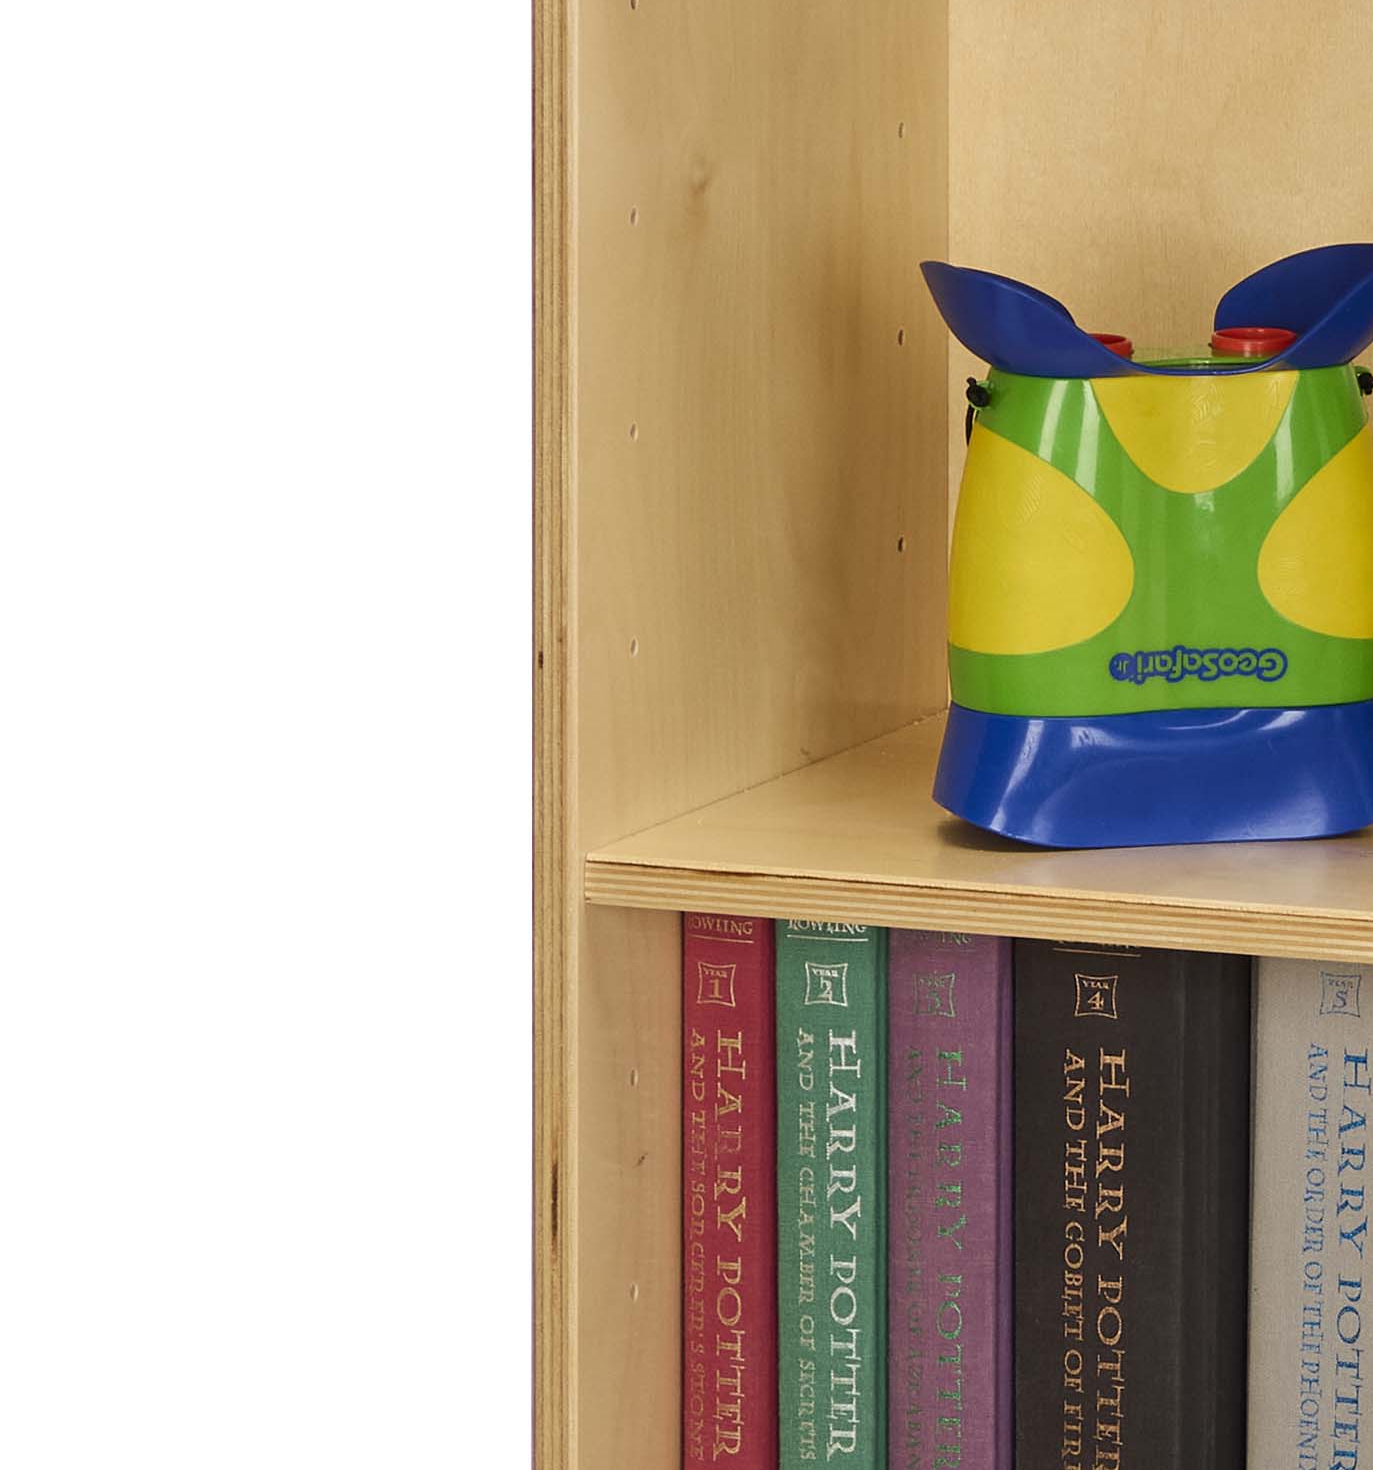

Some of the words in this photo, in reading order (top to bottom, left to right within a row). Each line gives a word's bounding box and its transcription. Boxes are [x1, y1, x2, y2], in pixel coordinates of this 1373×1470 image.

[1134, 647, 1286, 683] GeoSafari
[714, 1029, 746, 1243] HARRY
[826, 1028, 862, 1241] HARRY
[1062, 1139, 1088, 1213] THE
[1063, 1048, 1086, 1131] AND
[1094, 1047, 1130, 1261] HARRY
[1336, 1046, 1373, 1260] HARRY
[713, 1253, 746, 1462] POTTER
[826, 1253, 861, 1462] POTTER
[1060, 1221, 1086, 1342] GOBLET
[1062, 1349, 1085, 1388] OF
